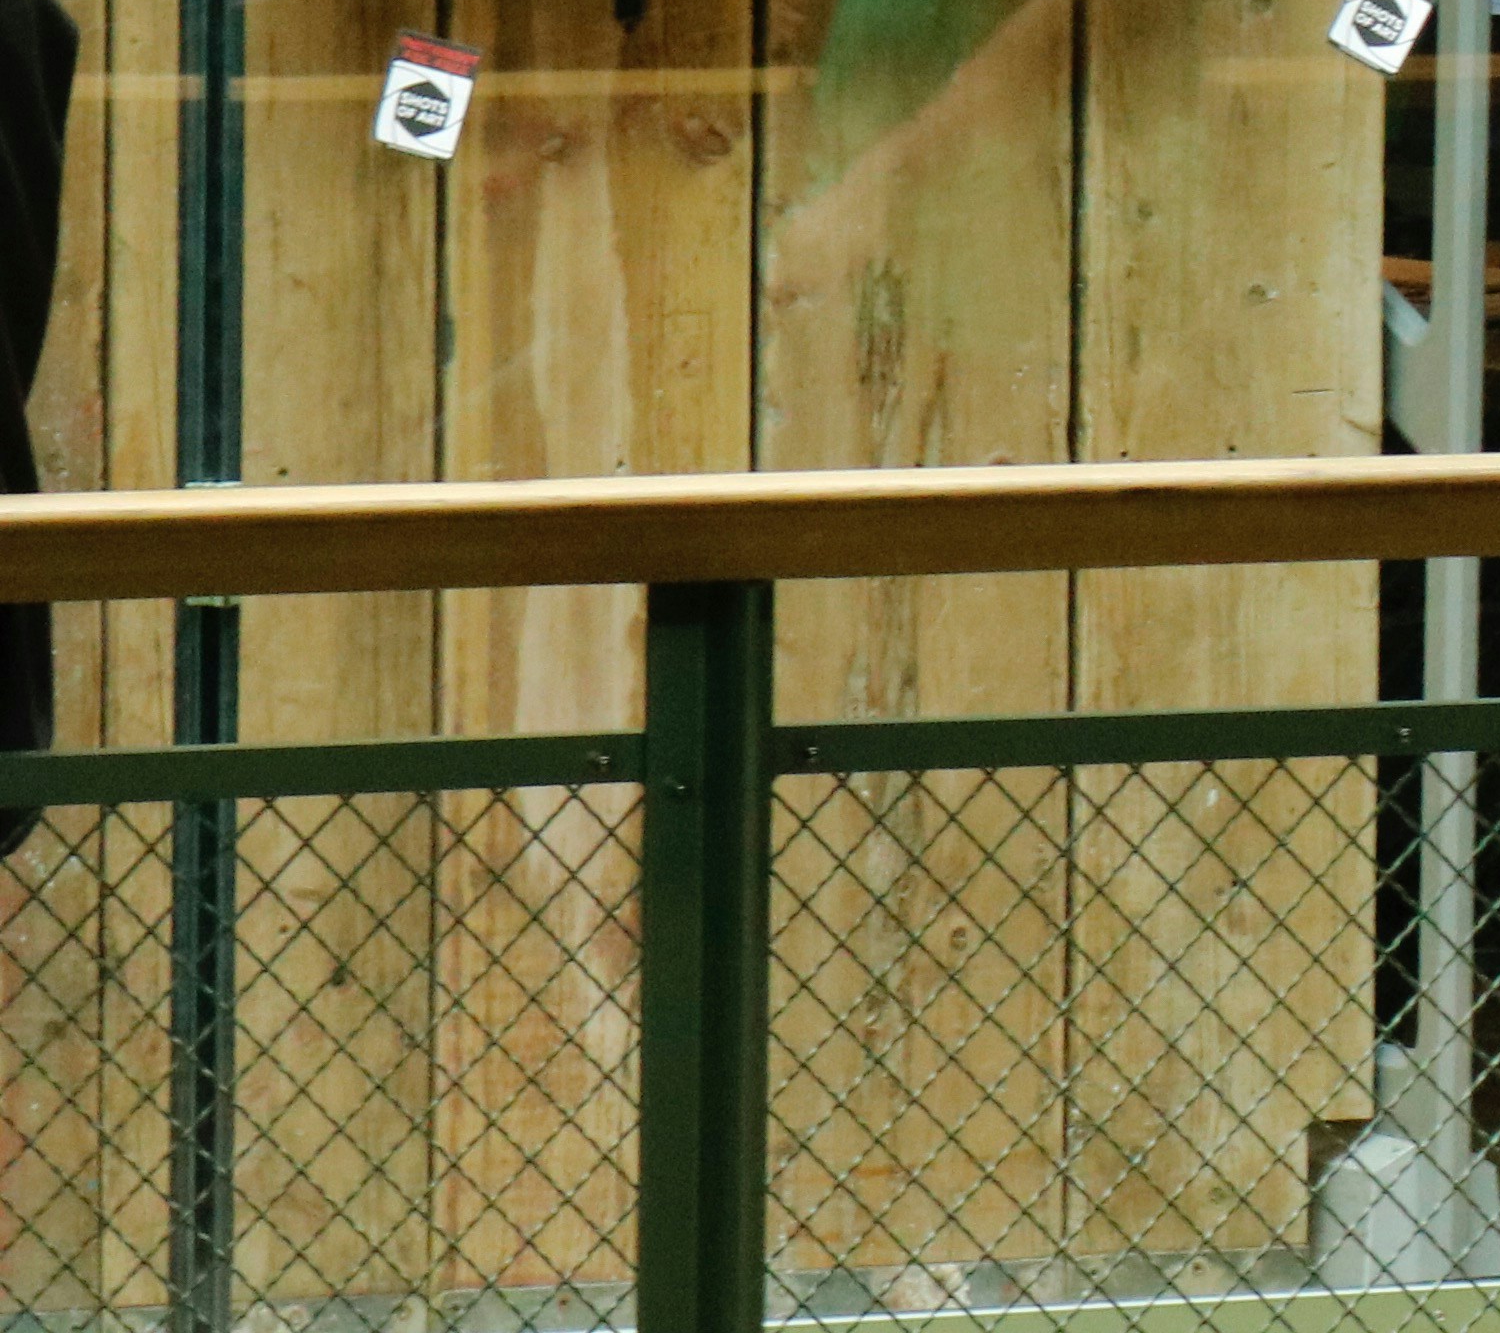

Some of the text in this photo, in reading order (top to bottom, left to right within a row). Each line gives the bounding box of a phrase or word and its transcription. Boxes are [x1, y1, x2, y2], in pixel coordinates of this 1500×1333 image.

[1354, 12, 1398, 42] OF ART
[400, 90, 449, 114] SHOTS
[396, 105, 446, 128] OF ART
